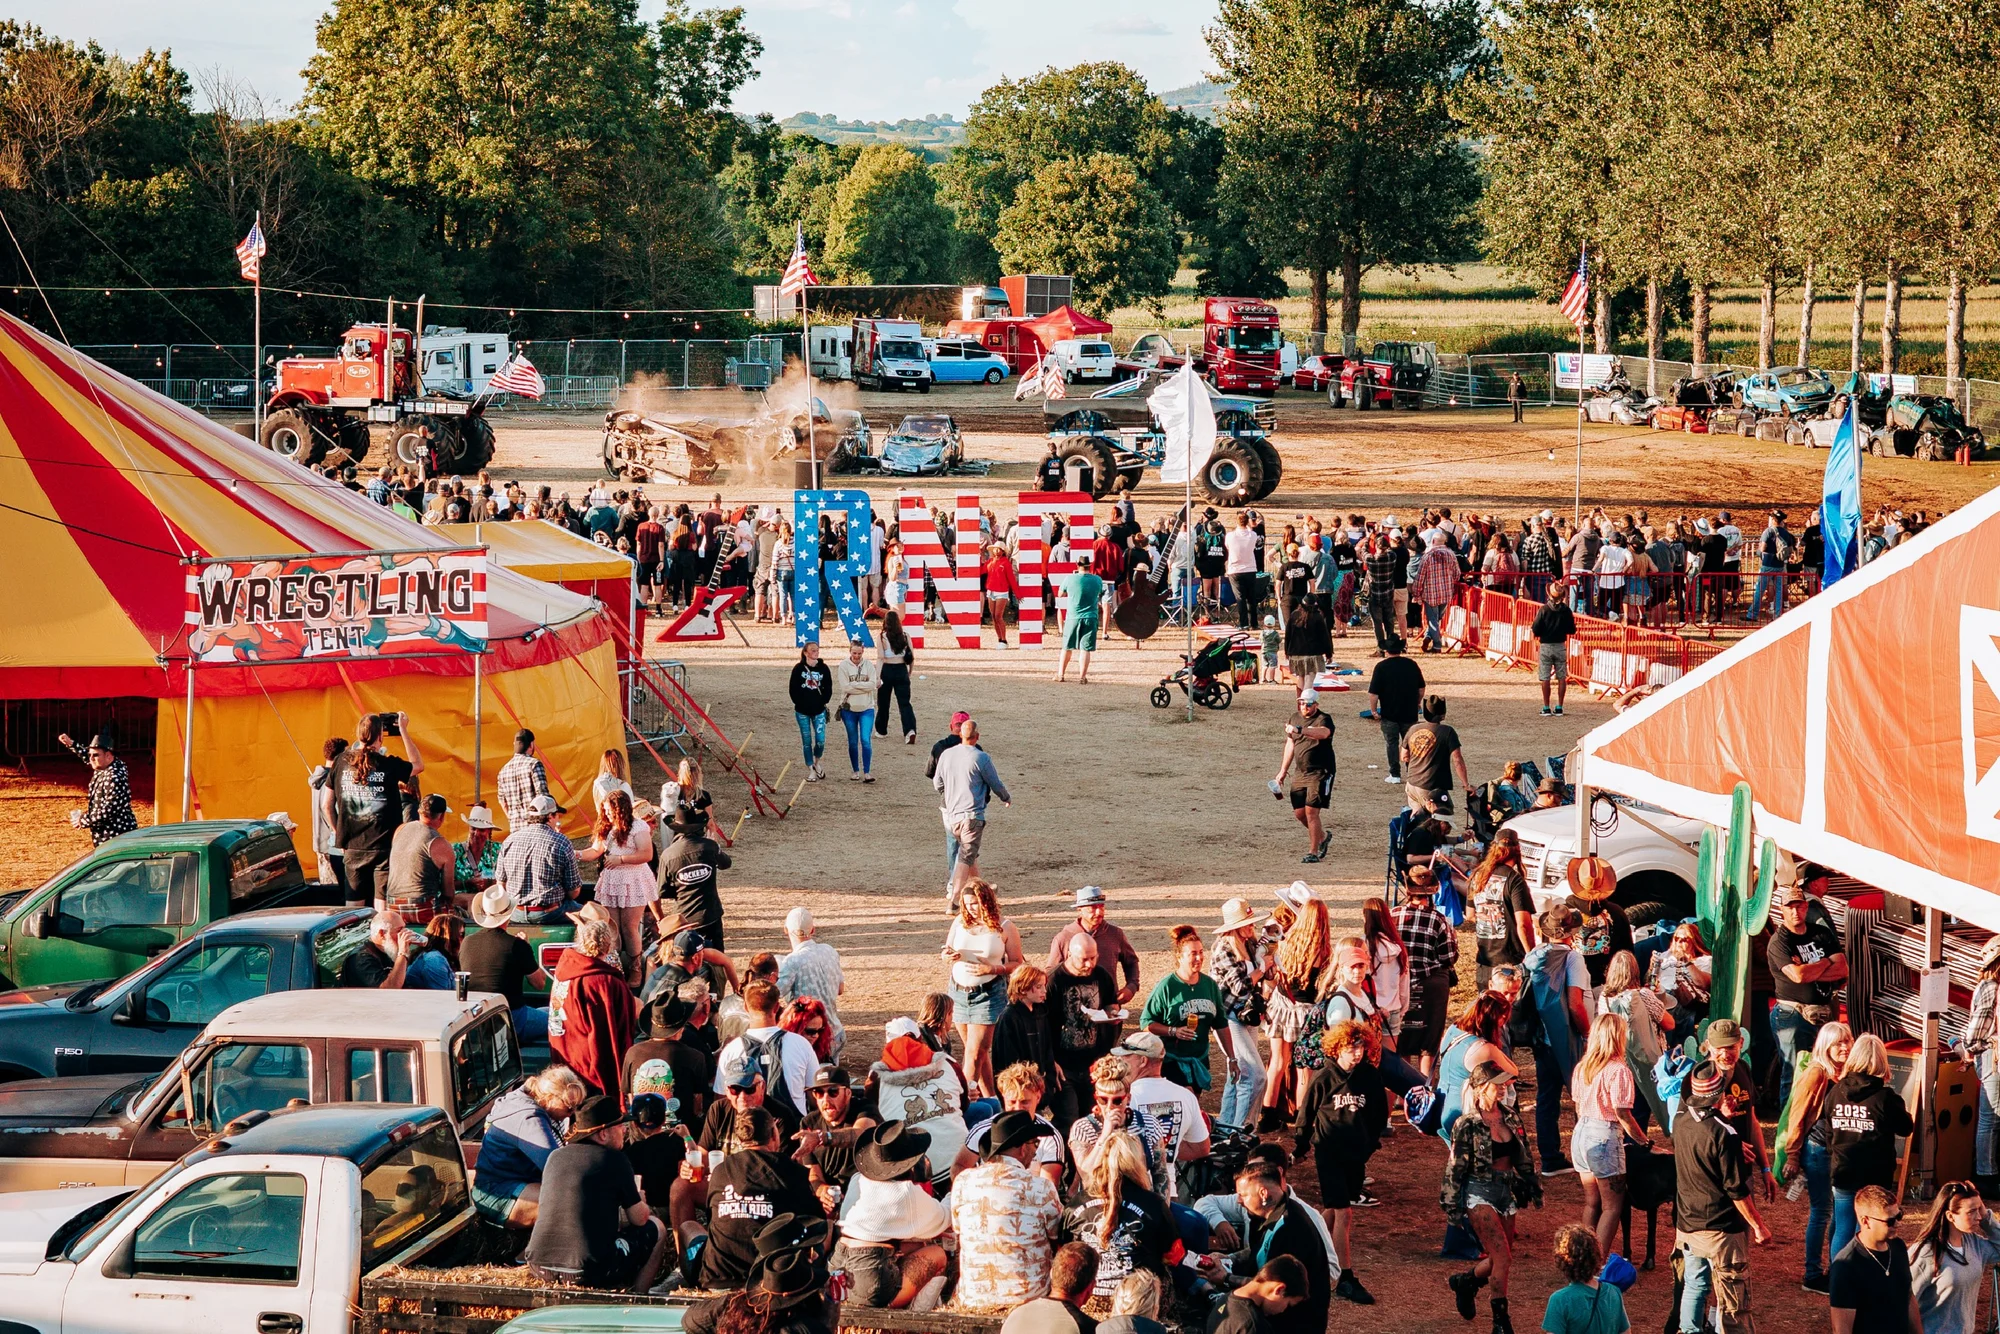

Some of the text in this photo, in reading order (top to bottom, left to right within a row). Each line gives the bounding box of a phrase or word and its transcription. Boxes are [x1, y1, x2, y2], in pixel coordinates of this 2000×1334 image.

[197, 568, 474, 627] WRESTLING
[303, 626, 366, 651] TENT
[1835, 1103, 1867, 1118] 2025
[718, 1202, 741, 1218] ROCK
[748, 1203, 774, 1219] RIBS
